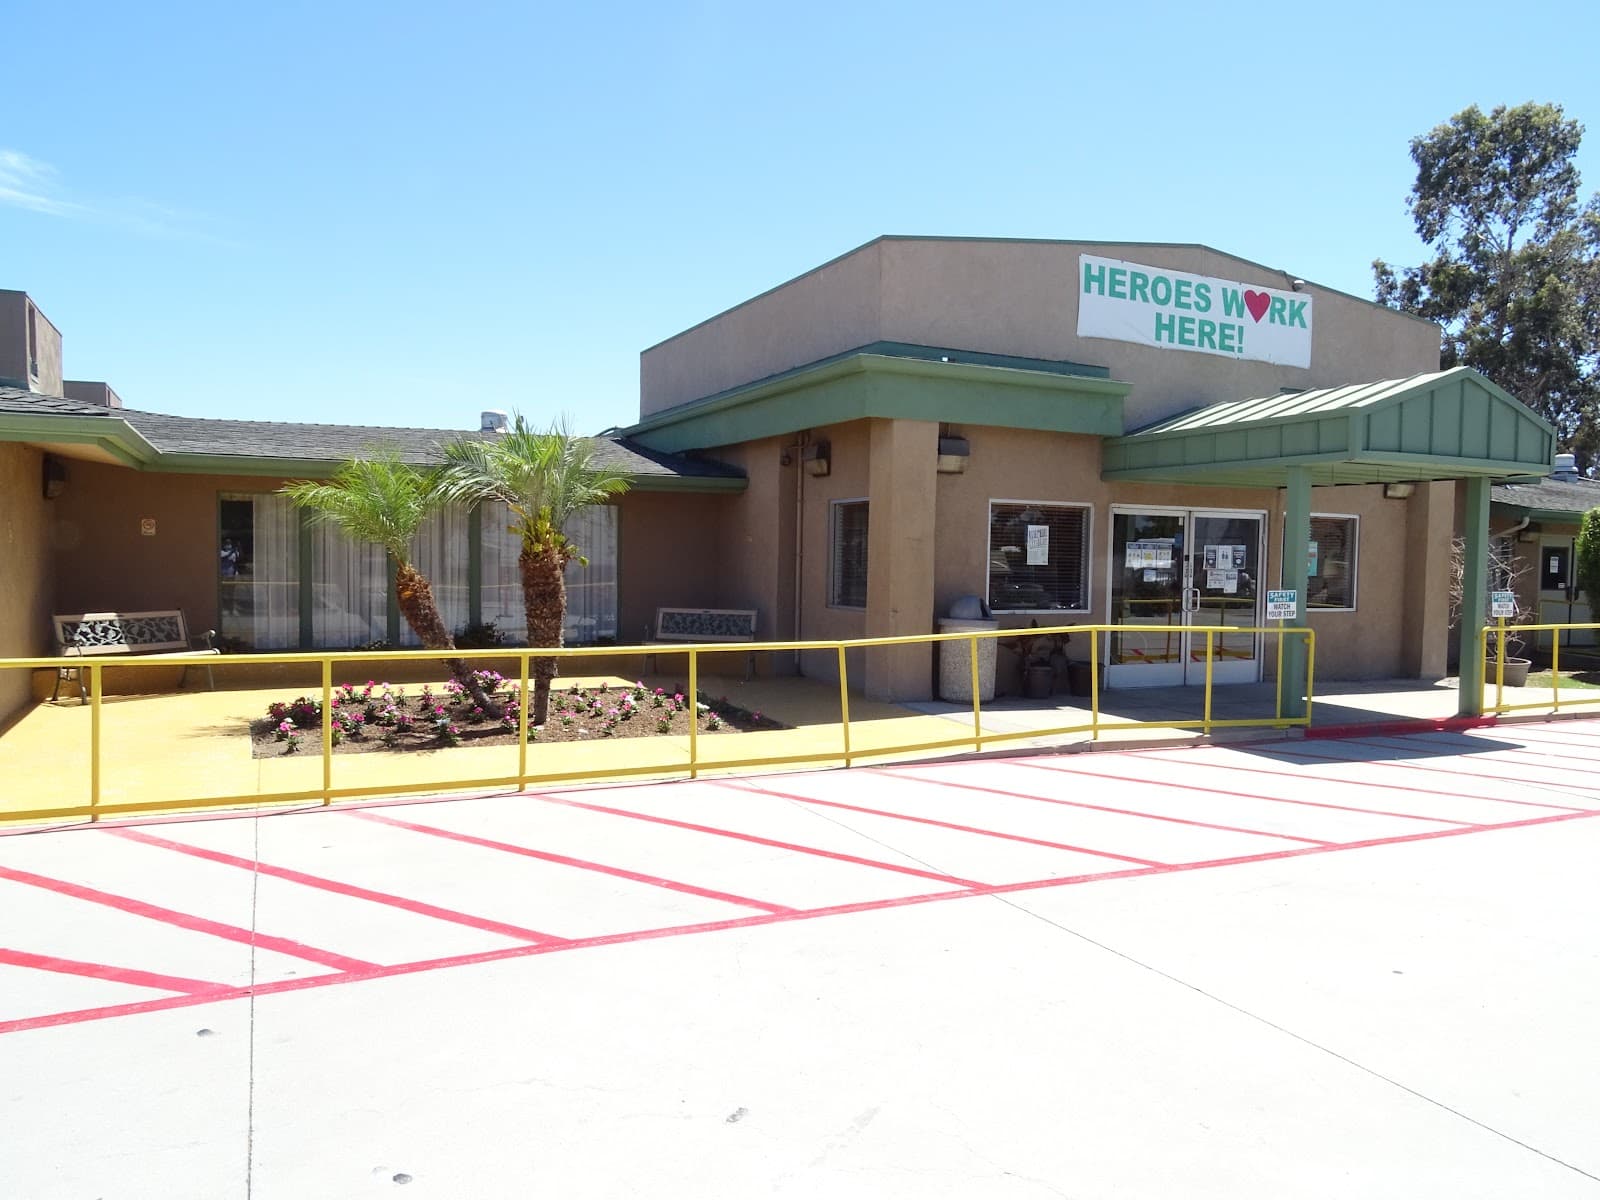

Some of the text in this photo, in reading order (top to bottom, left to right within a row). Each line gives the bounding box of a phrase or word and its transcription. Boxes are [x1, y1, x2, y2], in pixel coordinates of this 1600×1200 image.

[1083, 262, 1308, 329] HEROES WRK
[1154, 312, 1245, 354] HERE!
